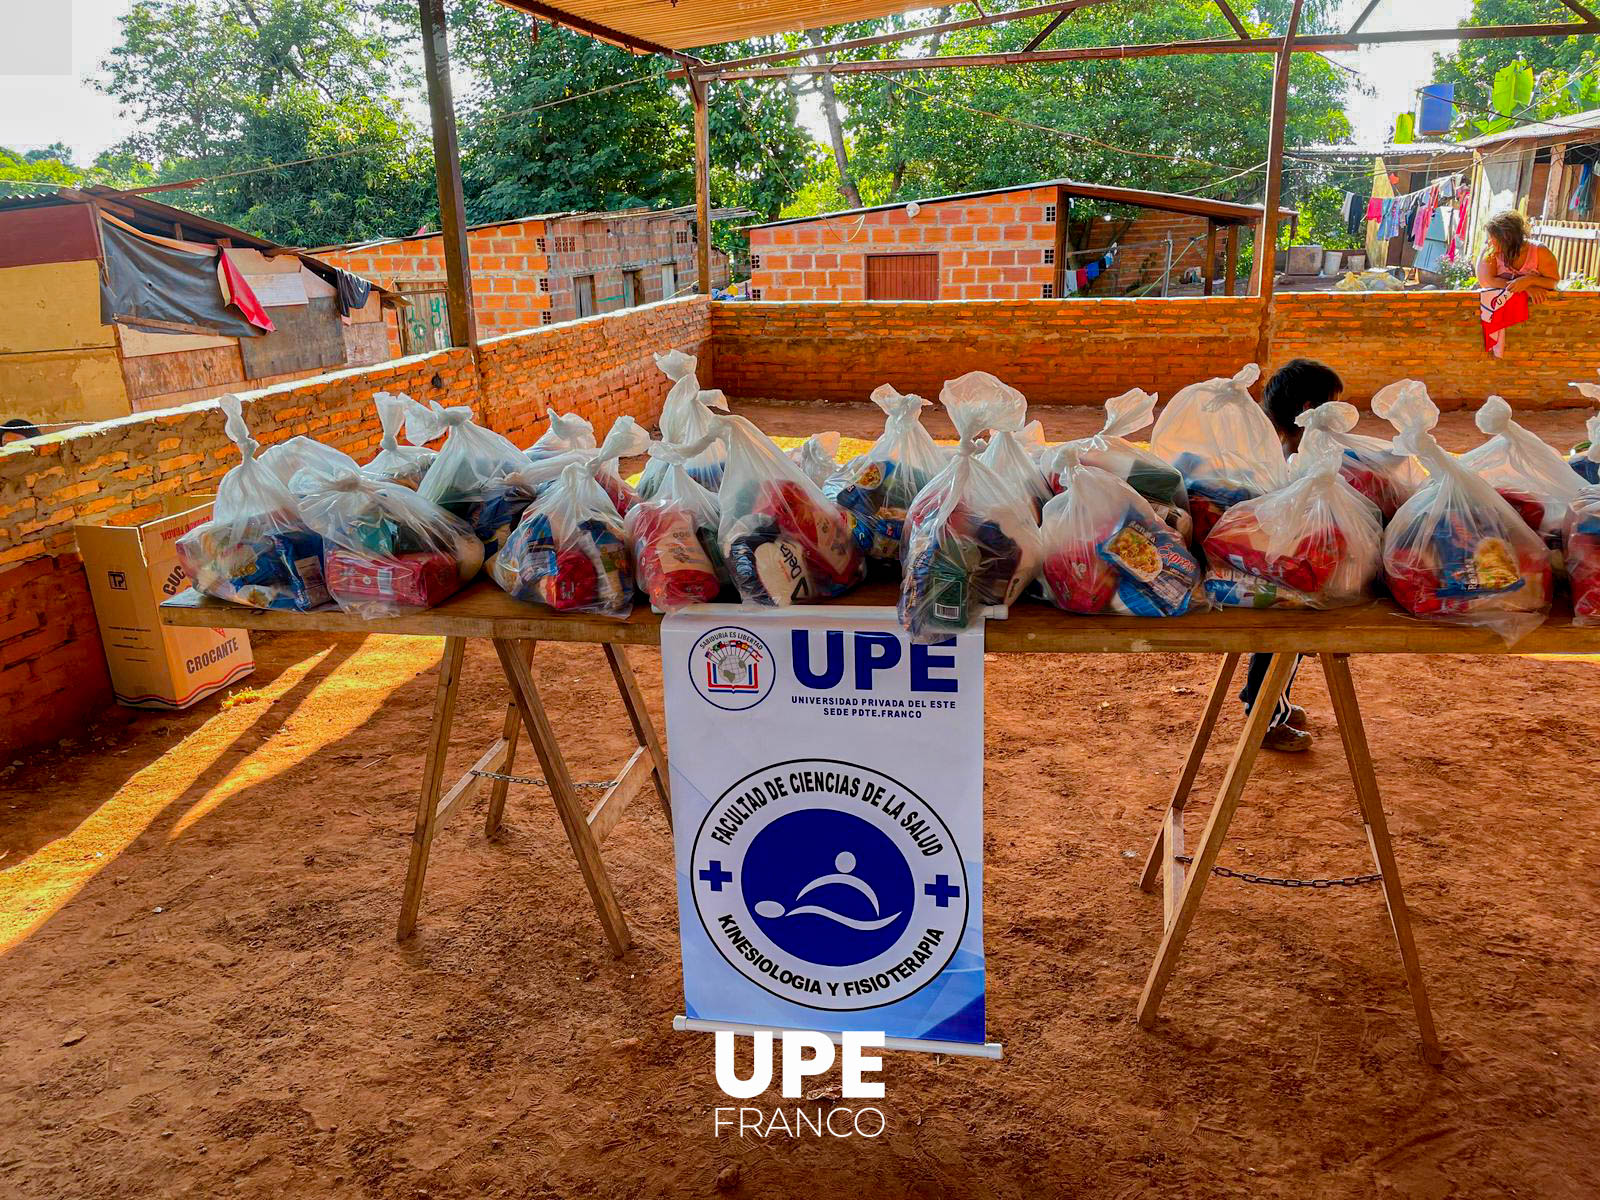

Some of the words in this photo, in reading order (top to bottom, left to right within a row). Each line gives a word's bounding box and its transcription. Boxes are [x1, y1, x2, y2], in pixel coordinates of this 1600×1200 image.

[186, 637, 239, 674] CROCANTE
[729, 631, 737, 639] ES
[737, 632, 763, 651] LIBERTAD
[791, 629, 958, 693] UPE
[791, 695, 858, 706] UNIVERSIDAD
[861, 698, 905, 708] PRIVADA
[908, 700, 927, 708] DEL
[930, 700, 956, 709] ESTE
[823, 707, 849, 716] SEDE
[711, 786, 768, 846] FACULTAD
[764, 776, 788, 801] DE
[789, 771, 861, 798] CIENCIAS
[861, 781, 886, 808] DE
[881, 794, 907, 820] LA
[900, 811, 944, 857] SALUD
[718, 914, 823, 995] KINESIOLOGIA
[826, 982, 840, 996] Y
[843, 927, 945, 997] FISIOTERAPIA
